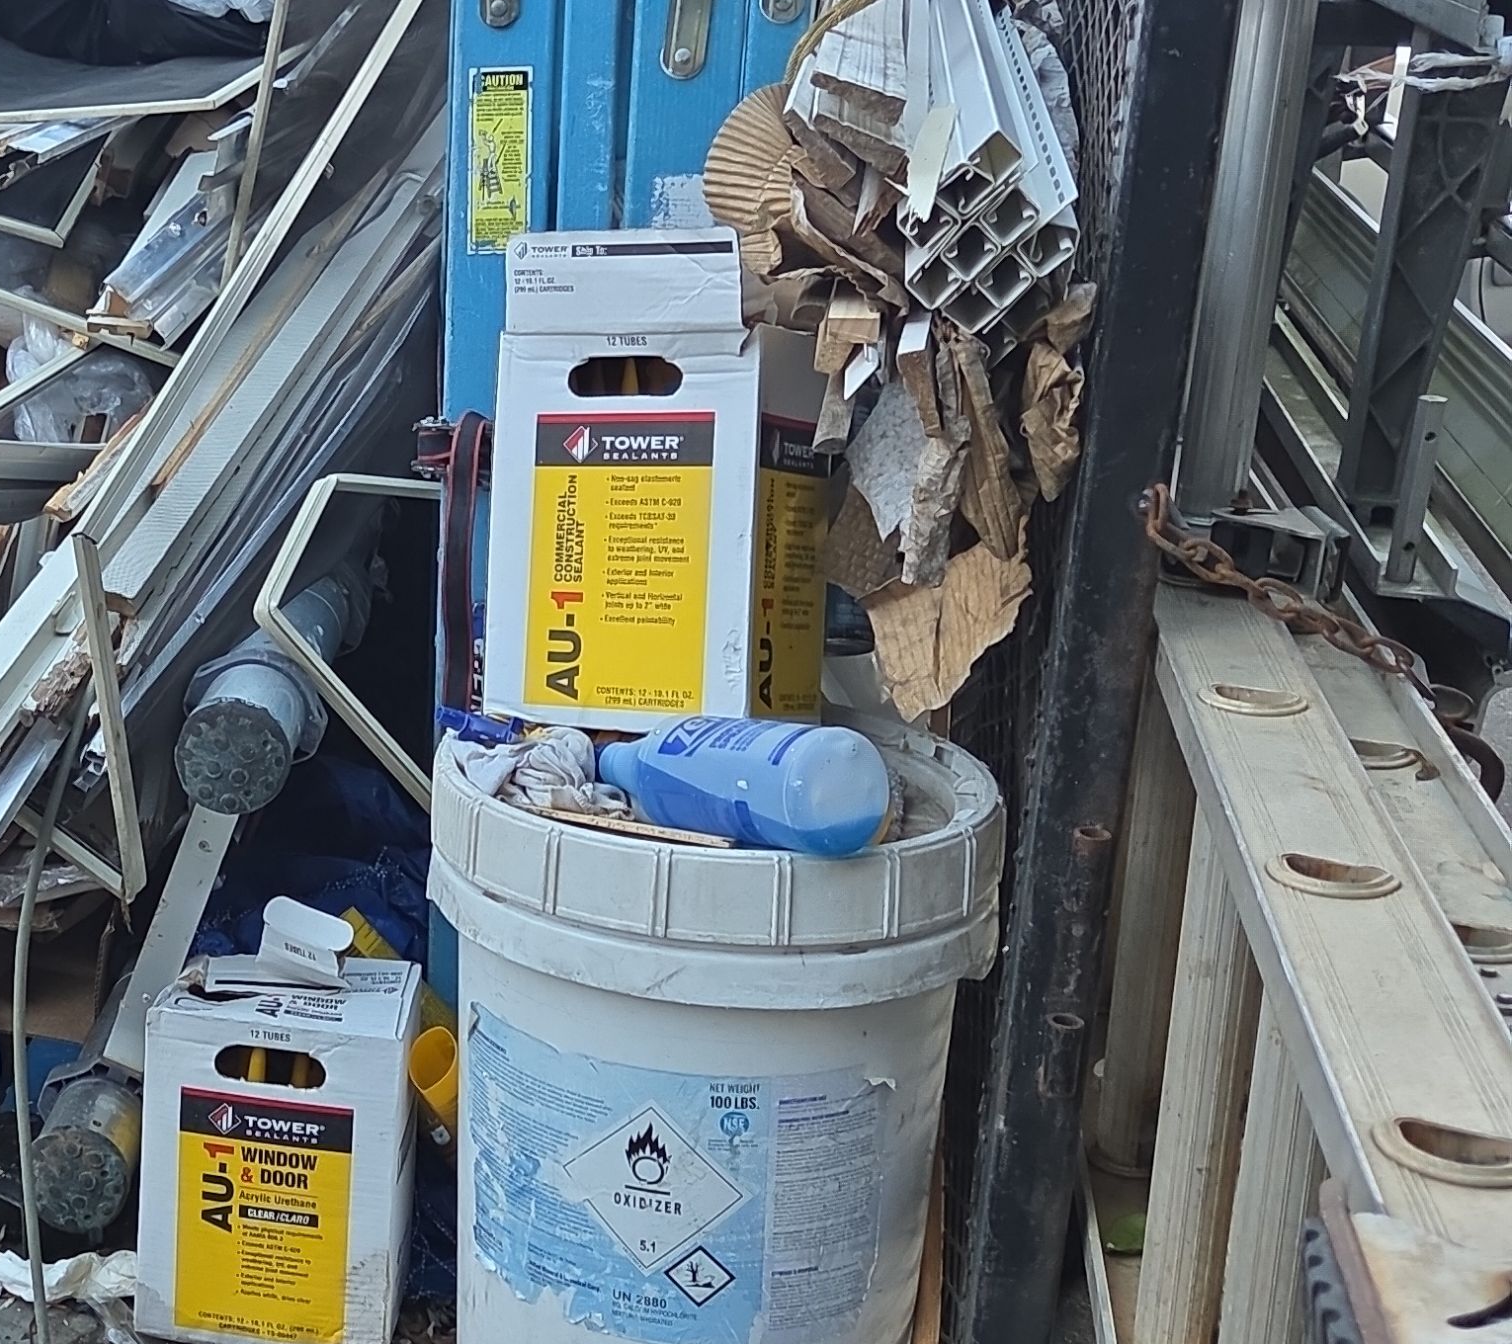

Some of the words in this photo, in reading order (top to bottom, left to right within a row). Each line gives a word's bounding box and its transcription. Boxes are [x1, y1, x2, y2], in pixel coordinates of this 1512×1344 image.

[531, 245, 567, 253] TOWER
[575, 245, 594, 256] Ship
[606, 336, 617, 346] 12
[620, 336, 648, 347] TUBES
[563, 474, 577, 583] CONSTRUCTION
[554, 491, 567, 582] COMMERCIAL
[573, 522, 585, 583] SEALANT
[545, 591, 584, 701] AU-1
[596, 686, 637, 697] CONTENTS:
[638, 688, 647, 697] 12
[638, 697, 685, 708] CARTRIDGES
[255, 995, 284, 1018] AU-
[291, 994, 347, 1006] WINDOW
[302, 1001, 338, 1011] DOOR
[250, 1029, 260, 1039] 12
[263, 1030, 291, 1042] TUBES
[709, 1083, 725, 1093] NET
[727, 1083, 760, 1094] WEIGHT
[710, 1096, 732, 1109] 100
[734, 1097, 760, 1110] LBS.
[722, 1117, 746, 1132] NSF
[245, 1129, 319, 1144] SEALANTS
[241, 1146, 318, 1171] WINDOW
[240, 1166, 254, 1184] &
[260, 1169, 309, 1190] DOOR
[201, 1142, 235, 1233] AU-1
[239, 1190, 272, 1204] Acrylic
[274, 1194, 317, 1209] Urethane
[613, 1192, 682, 1216] OXIDIZER
[639, 1240, 657, 1254] 5.1
[612, 1288, 631, 1302] UN
[635, 1294, 668, 1310] 2880
